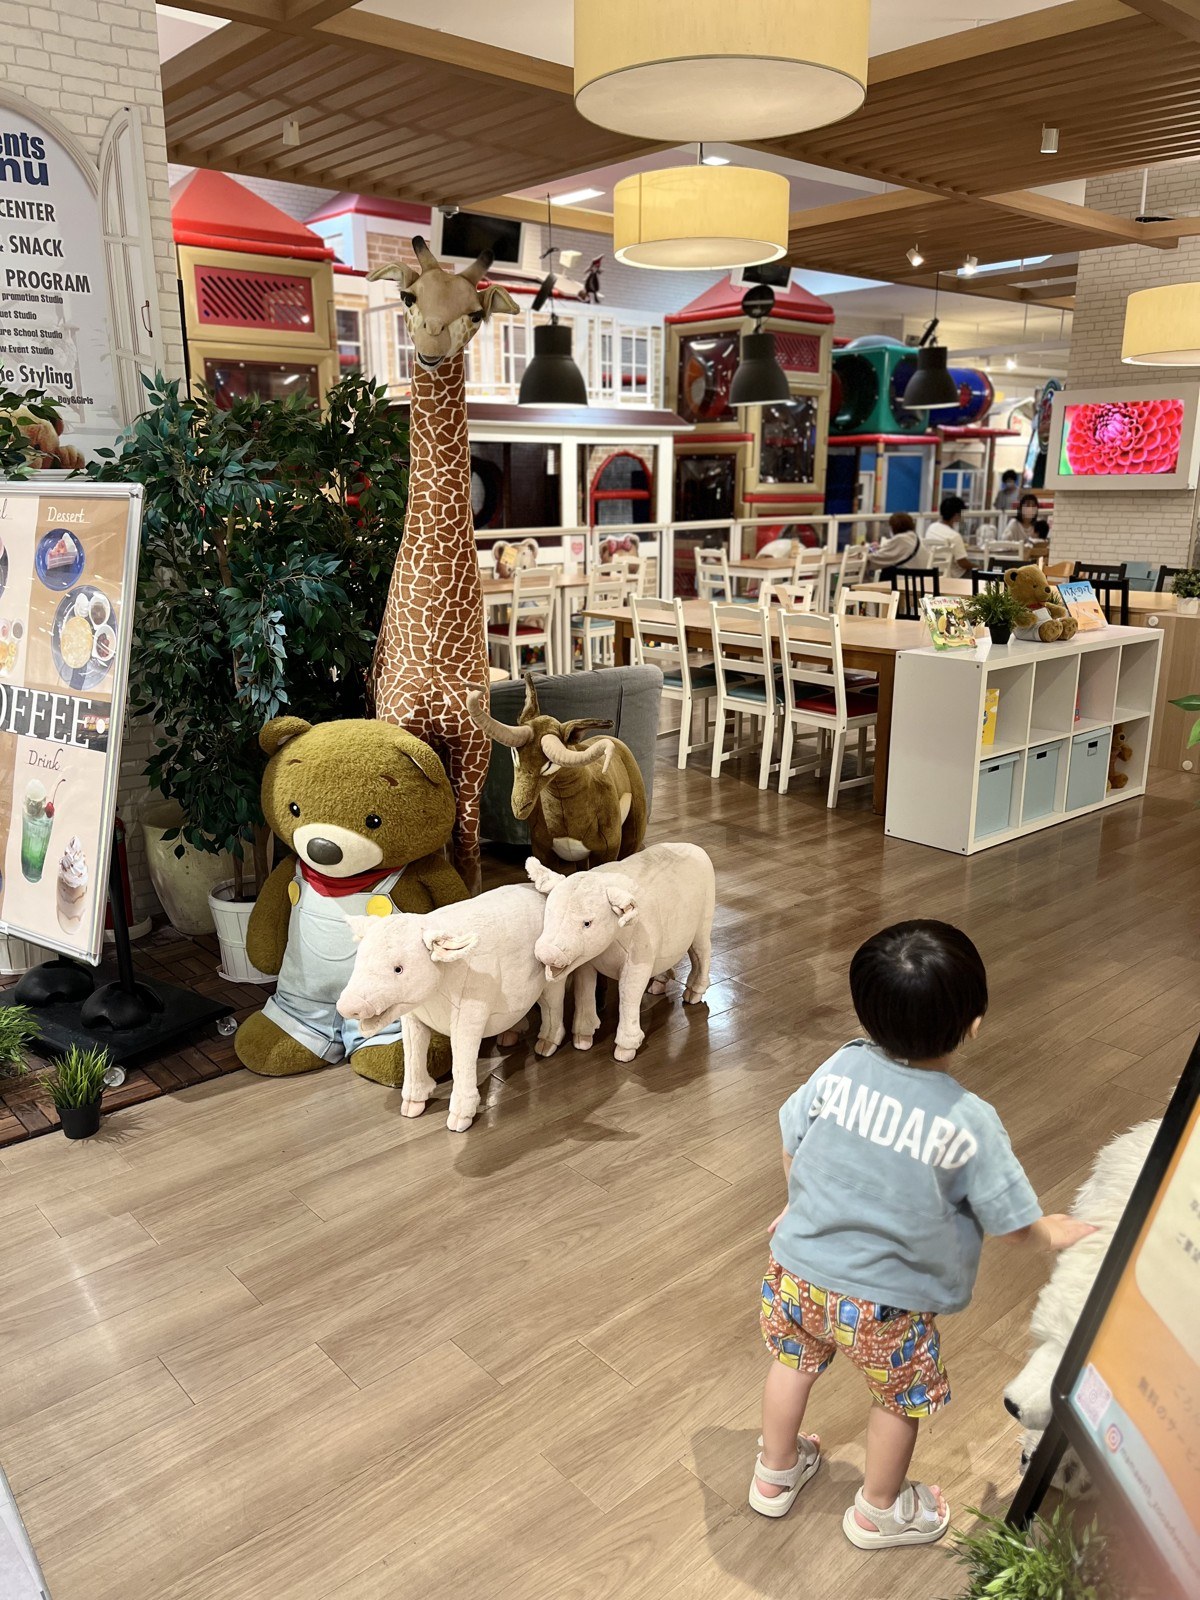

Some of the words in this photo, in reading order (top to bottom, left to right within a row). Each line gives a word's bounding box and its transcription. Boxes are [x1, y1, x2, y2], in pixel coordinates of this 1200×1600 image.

[0, 132, 45, 160] nts
[9, 235, 64, 258] SNACK
[5, 269, 91, 293] PROGRAM
[40, 294, 63, 304] Studio
[13, 310, 37, 320] Studio
[13, 327, 38, 337] School
[39, 329, 63, 339] Studio
[8, 344, 29, 354] Event
[30, 345, 54, 355] Studio
[19, 365, 73, 389] Styling
[47, 506, 85, 523] Dessert
[28, 748, 64, 771] Drink
